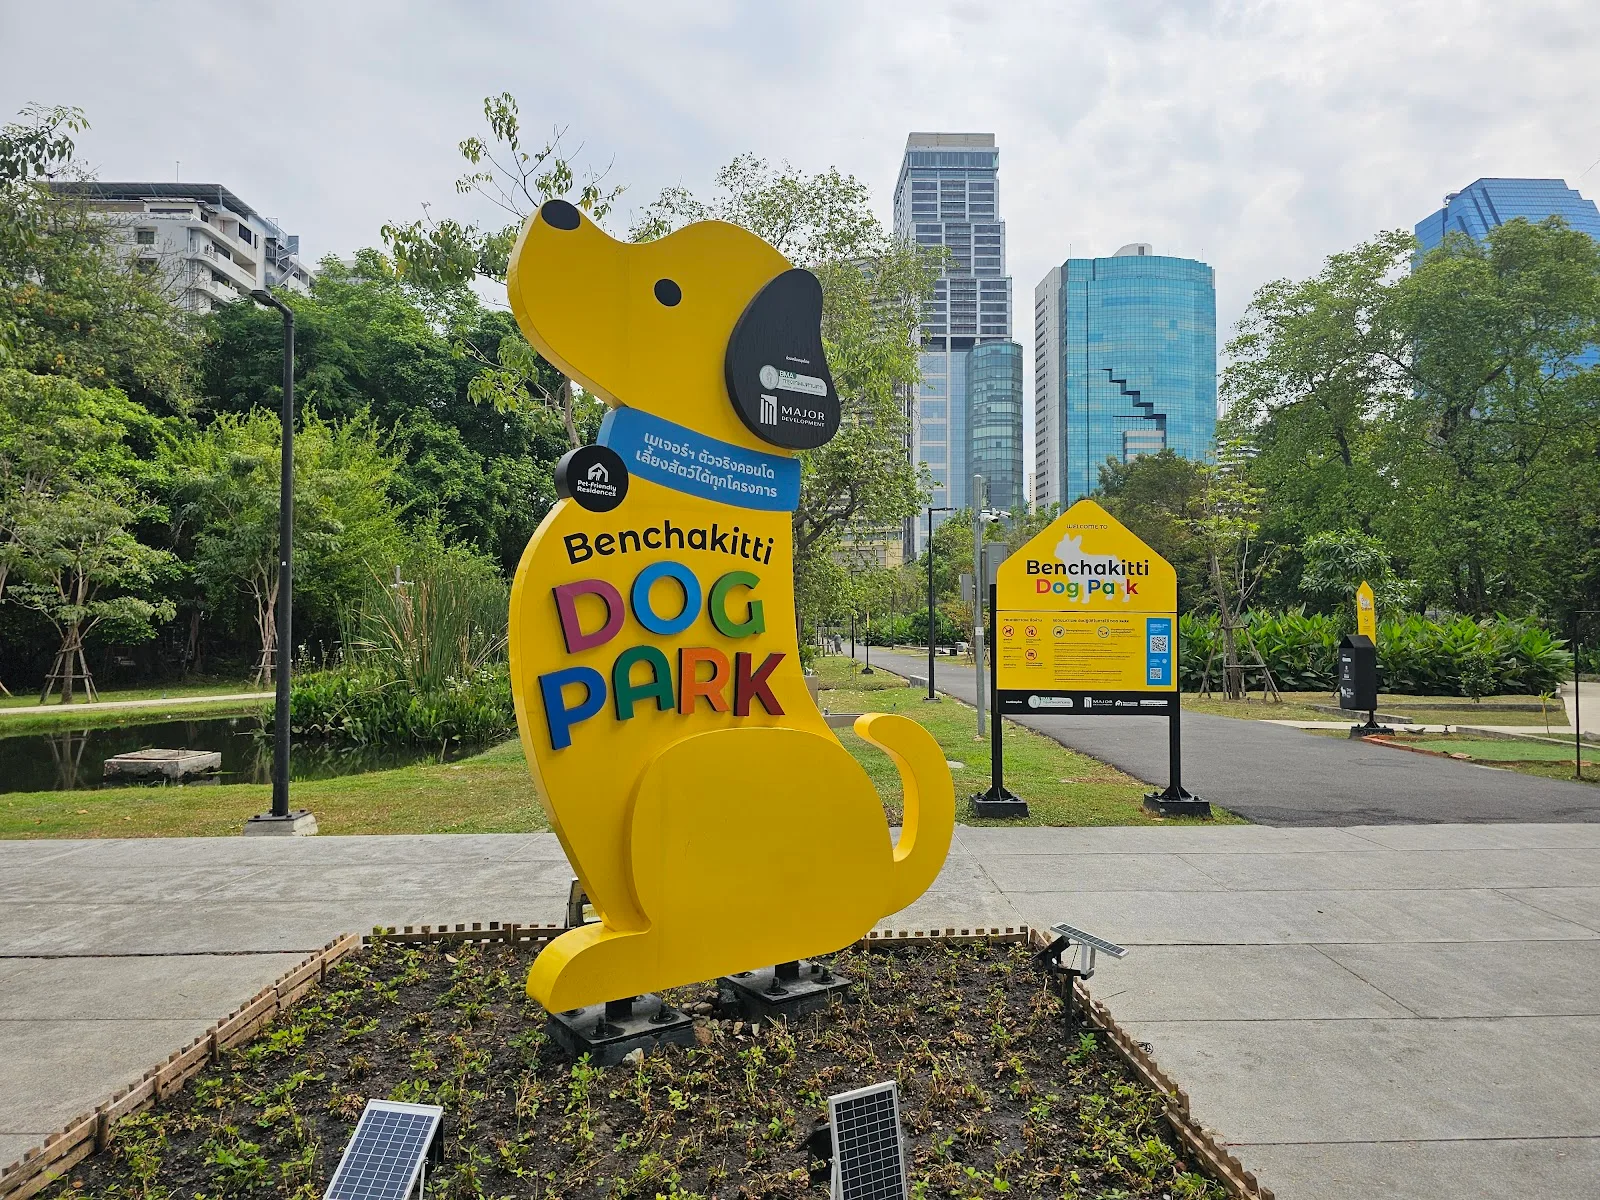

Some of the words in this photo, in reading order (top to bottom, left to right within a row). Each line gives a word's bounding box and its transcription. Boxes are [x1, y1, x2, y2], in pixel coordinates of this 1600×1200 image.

[781, 405, 825, 421] MAJOR
[781, 415, 825, 428] DEVELOPMENT
[635, 445, 778, 498] เลี้ยงสัตว์ได้ทุกโครงการ
[643, 431, 696, 460] เมเจอร์ฯ
[698, 448, 775, 480] ตัวจริงคอนโด
[563, 519, 775, 565] Benchakitti
[1026, 558, 1149, 576] Benchakitti
[1036, 578, 1079, 598] Dog
[1087, 578, 1139, 595] Pak
[552, 560, 766, 654] DOG
[538, 645, 787, 750] PARK
